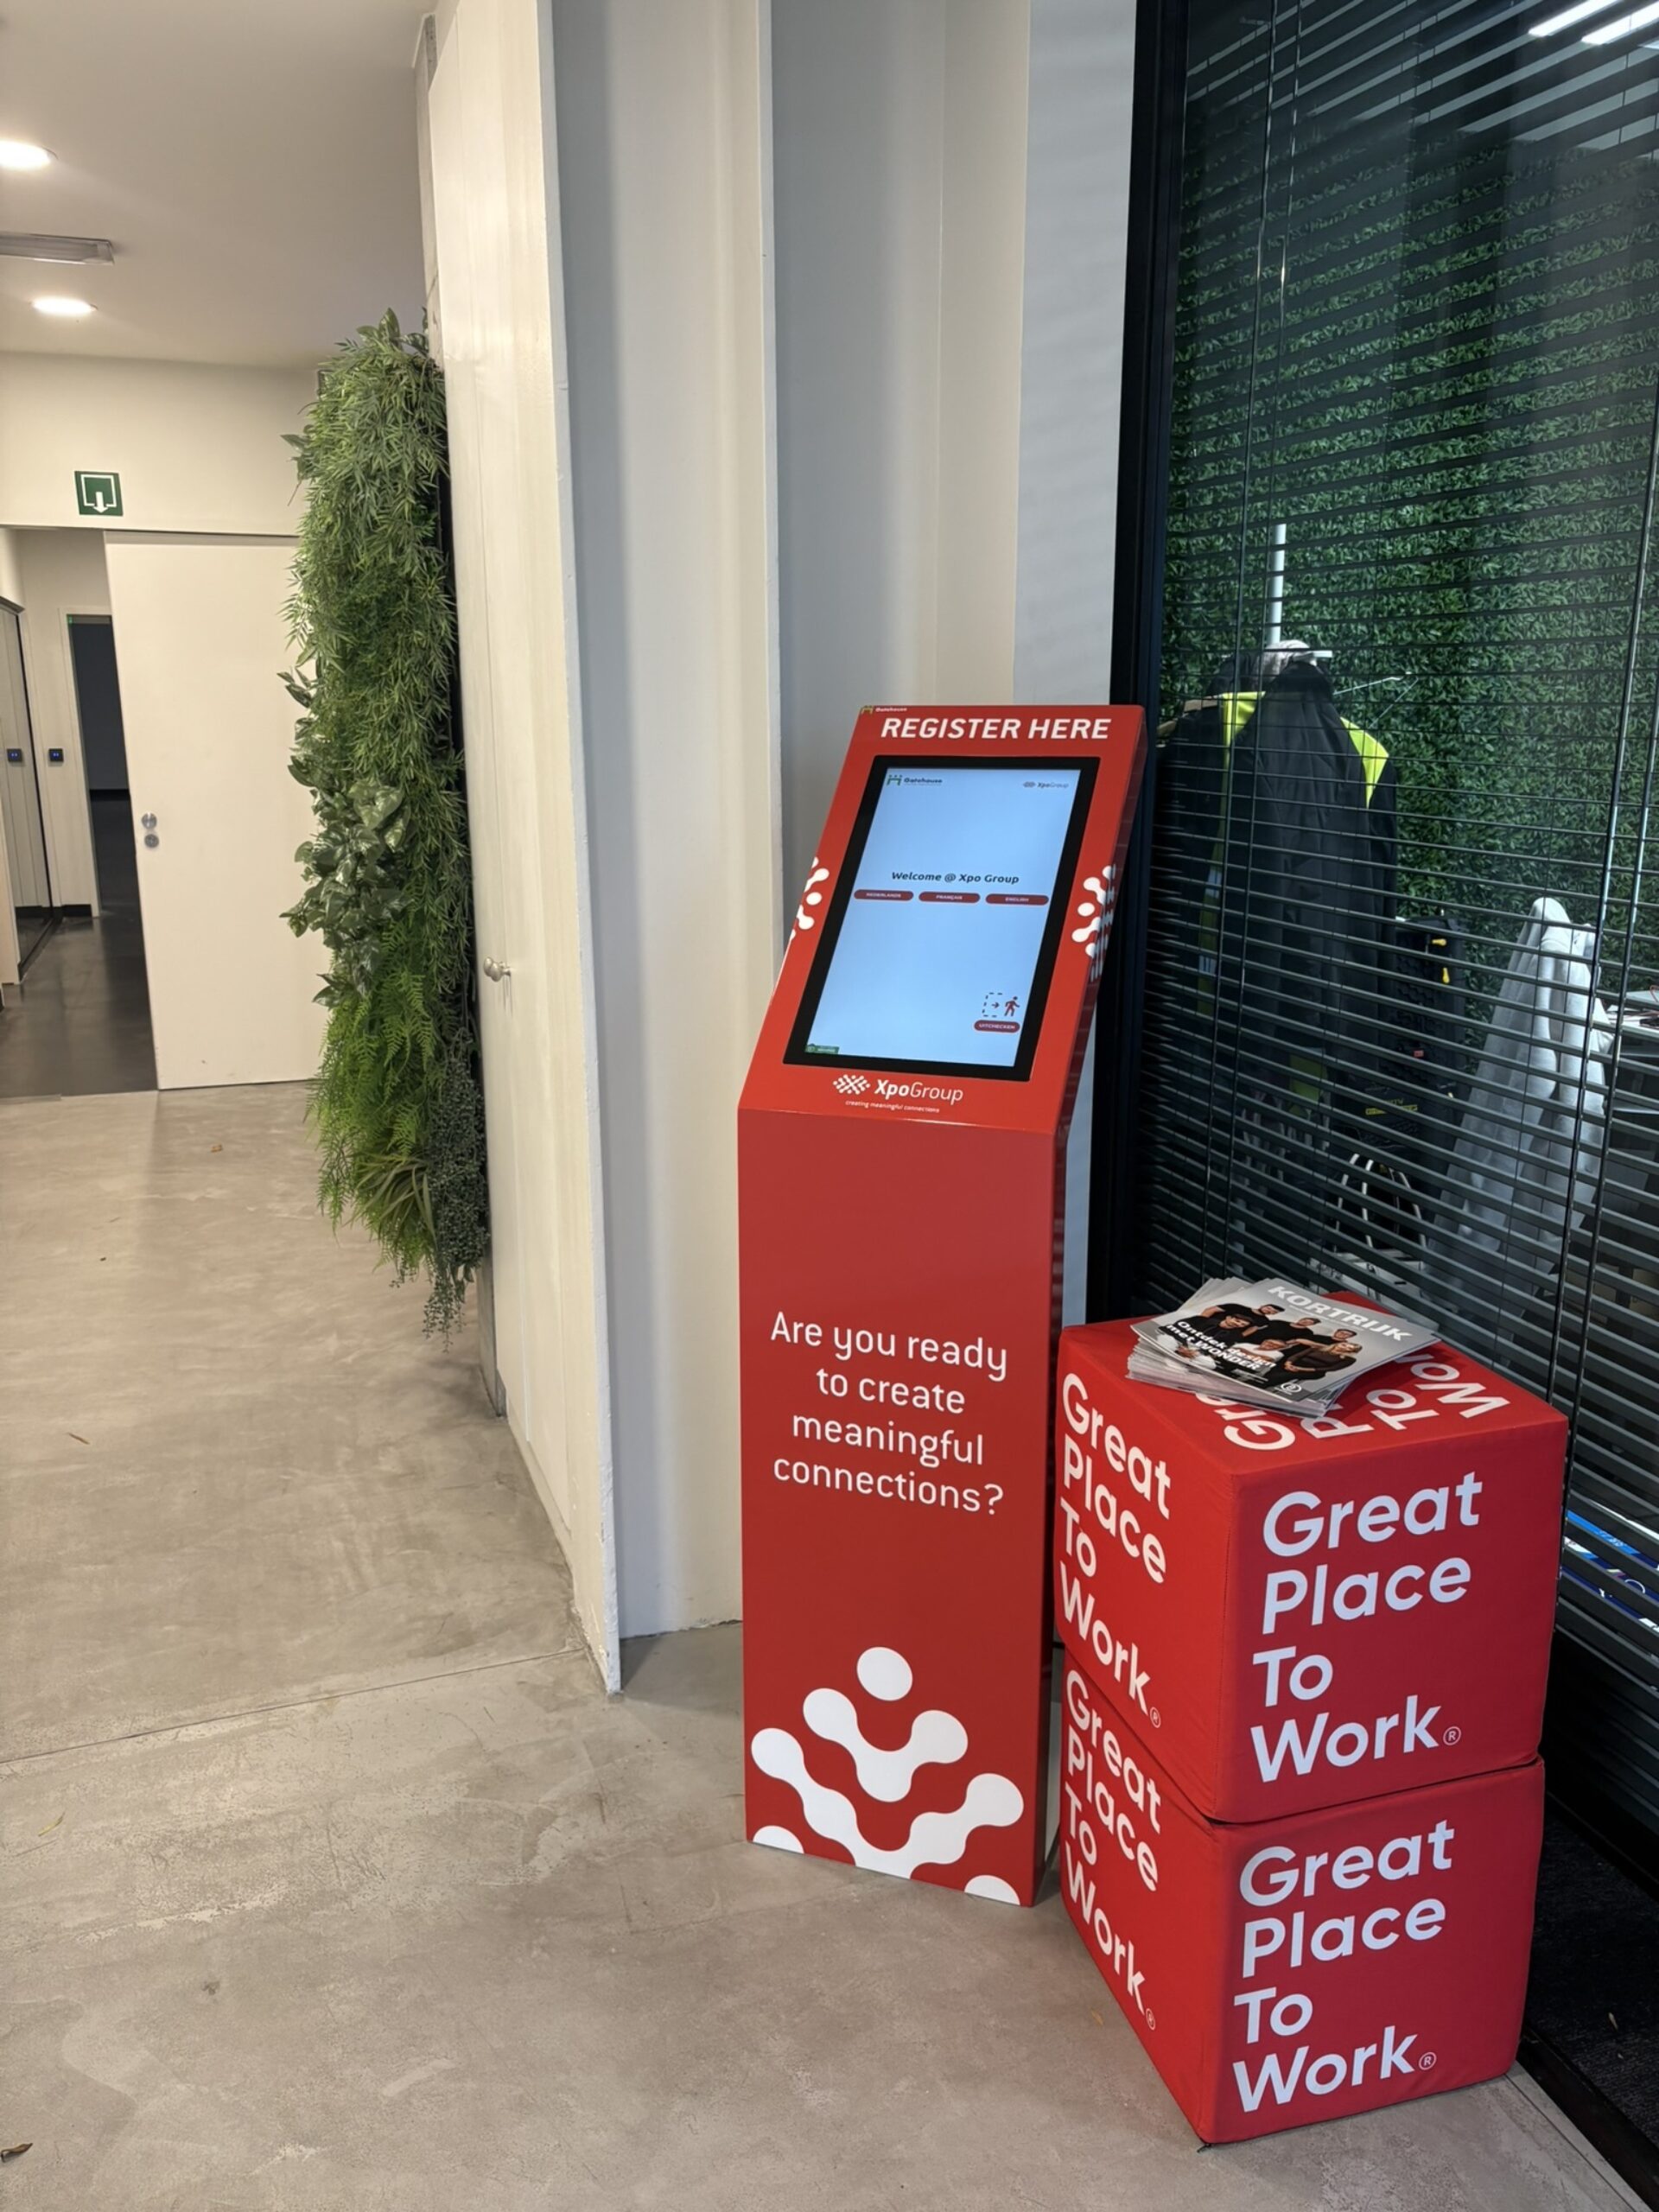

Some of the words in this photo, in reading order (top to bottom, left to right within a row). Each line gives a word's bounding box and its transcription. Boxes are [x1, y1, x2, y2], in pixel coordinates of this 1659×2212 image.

[880, 717, 1021, 740] REGISTER
[1027, 718, 1112, 741] HERE
[891, 872, 942, 882] Welcome
[944, 872, 957, 883] @
[958, 874, 982, 884] Xpo
[984, 874, 1020, 885] Group
[845, 1098, 869, 1109] creating
[870, 1102, 904, 1112] meaningful
[904, 1104, 940, 1114] connections
[874, 1078, 964, 1106] XpoGroup
[1268, 1285, 1413, 1341] KORTRIJK
[771, 1311, 823, 1346] Are
[834, 1326, 896, 1362] you
[908, 1337, 1007, 1382] ready
[1166, 1324, 1197, 1344] met
[1195, 1339, 1262, 1371] WONDER
[1177, 1321, 1228, 1350] Ontdek
[1227, 1348, 1277, 1369] design
[816, 1368, 848, 1397] to
[859, 1377, 965, 1414] create
[1365, 1388, 1440, 1432] To
[792, 1414, 983, 1468] meaningful
[1062, 1373, 1171, 1521] Great
[773, 1458, 1004, 1516] connections?
[1063, 1433, 1166, 1584] Place
[1262, 1471, 1484, 1557] Great
[1060, 1497, 1097, 1578] To
[1262, 1557, 1472, 1635] Place
[1253, 1645, 1334, 1707] To
[1066, 1669, 1161, 1835] Great
[1065, 1782, 1097, 1866] To
[1068, 1725, 1159, 1892] Place
[1239, 1820, 1455, 1907] Great
[1243, 1898, 1446, 1979] Place
[1233, 1986, 1313, 2044] To
